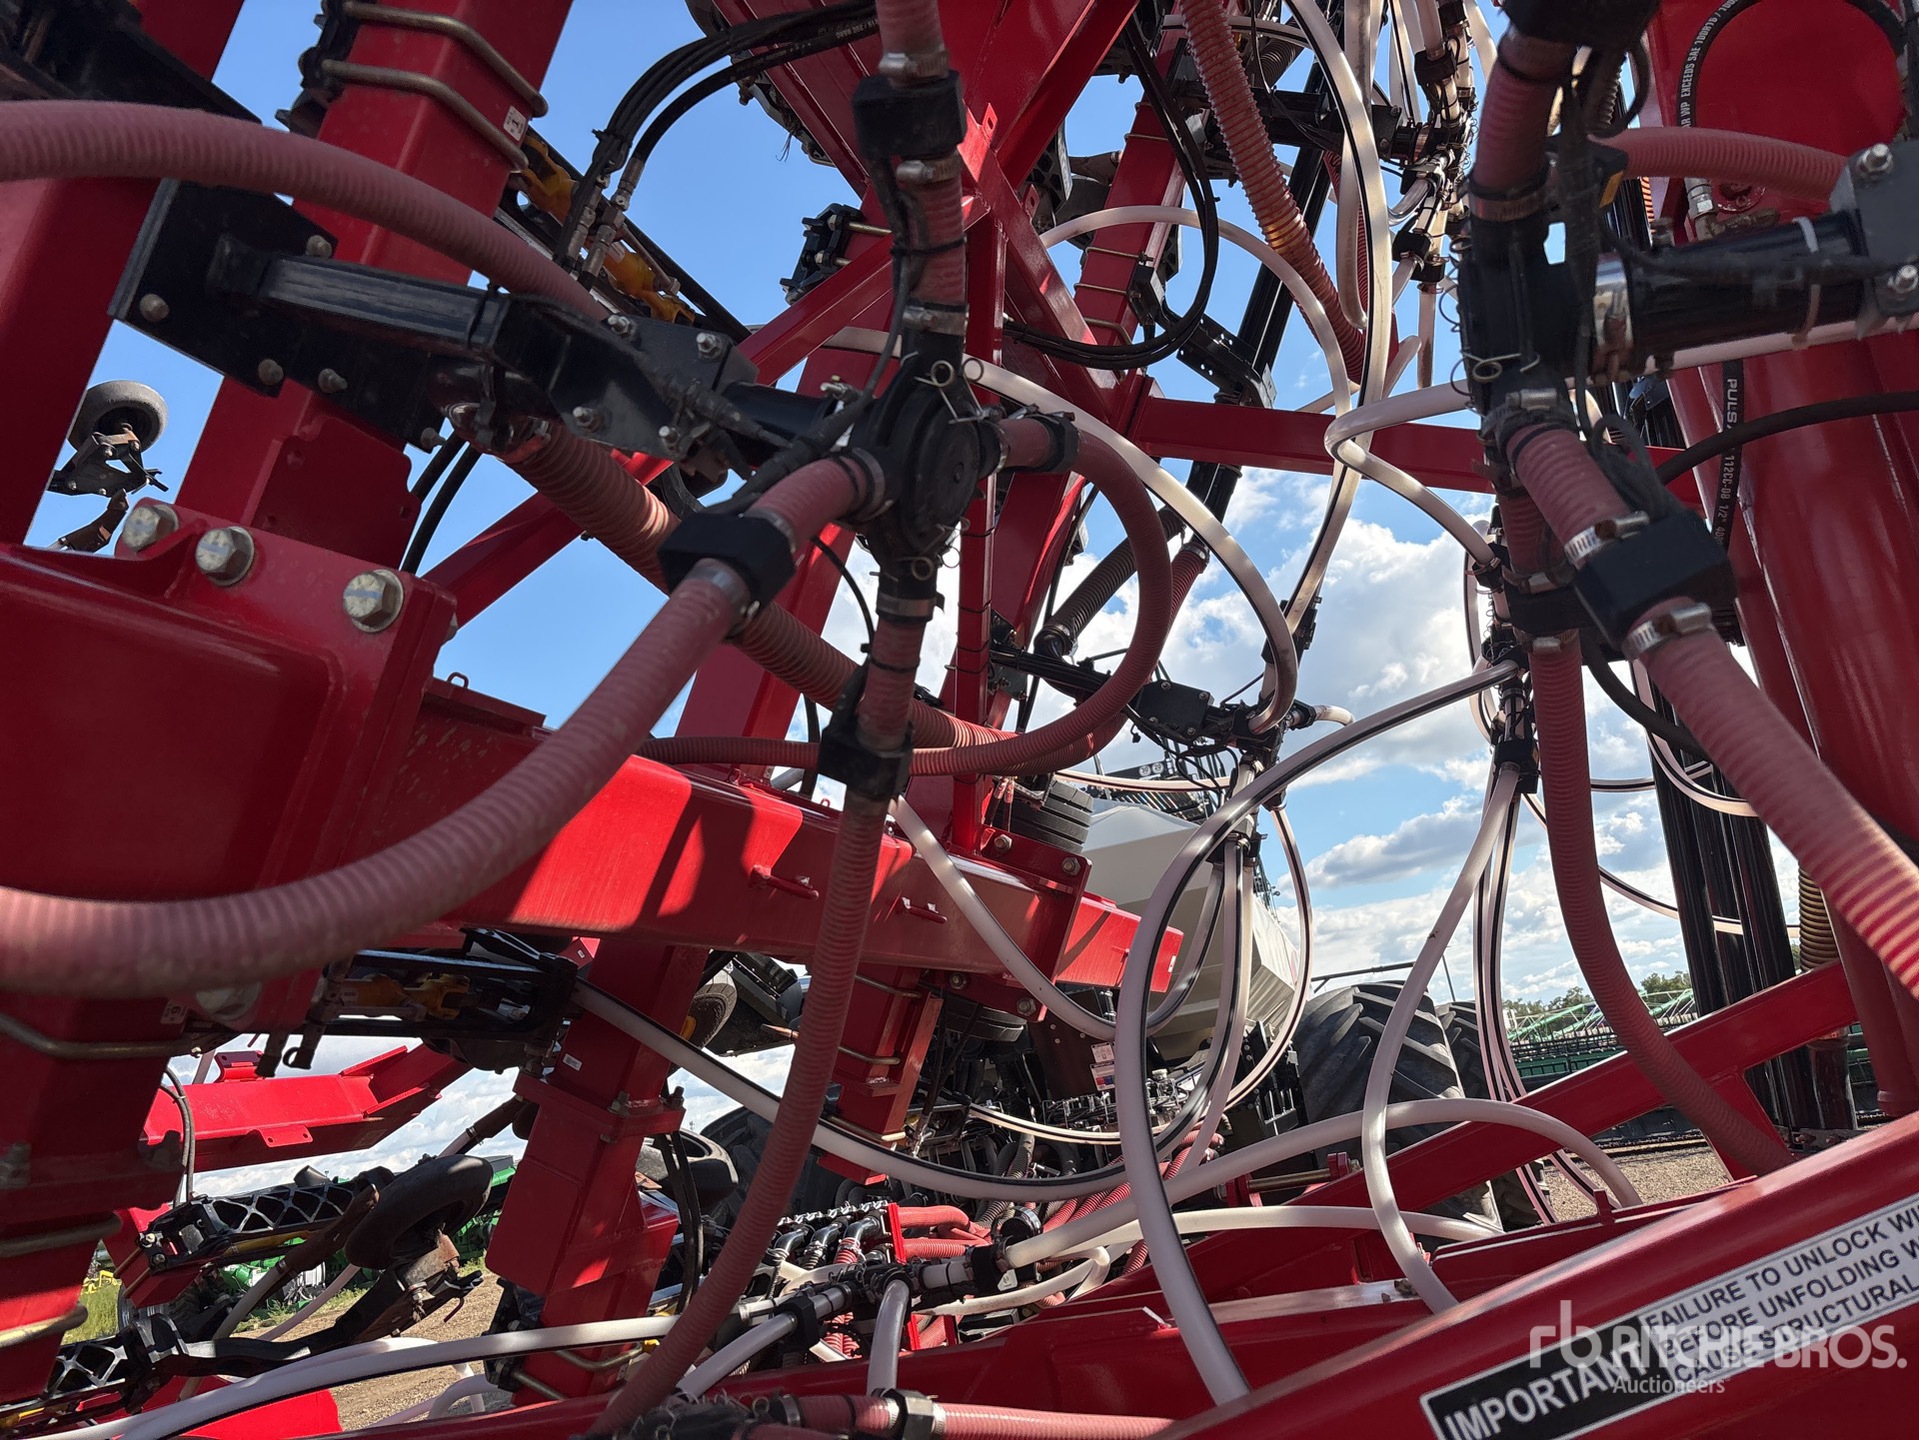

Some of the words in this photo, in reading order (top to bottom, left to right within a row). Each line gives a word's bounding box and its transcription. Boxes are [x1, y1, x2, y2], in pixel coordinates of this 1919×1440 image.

[1681, 63, 1695, 97] EXCEEDS
[1688, 46, 1701, 61] SAE
[1681, 102, 1691, 116] WP
[1645, 1281, 1746, 1334] FAILURE
[1748, 1267, 1781, 1293] TO
[1784, 1222, 1889, 1278] UNLOCK
[1662, 1307, 1759, 1359] BEFORE
[1761, 1249, 1900, 1319] UNFOLDING
[1674, 1339, 1758, 1383] CAUSE
[1758, 1274, 1919, 1350] STRUCTURAL
[1444, 1341, 1648, 1440] IMPORTANT
